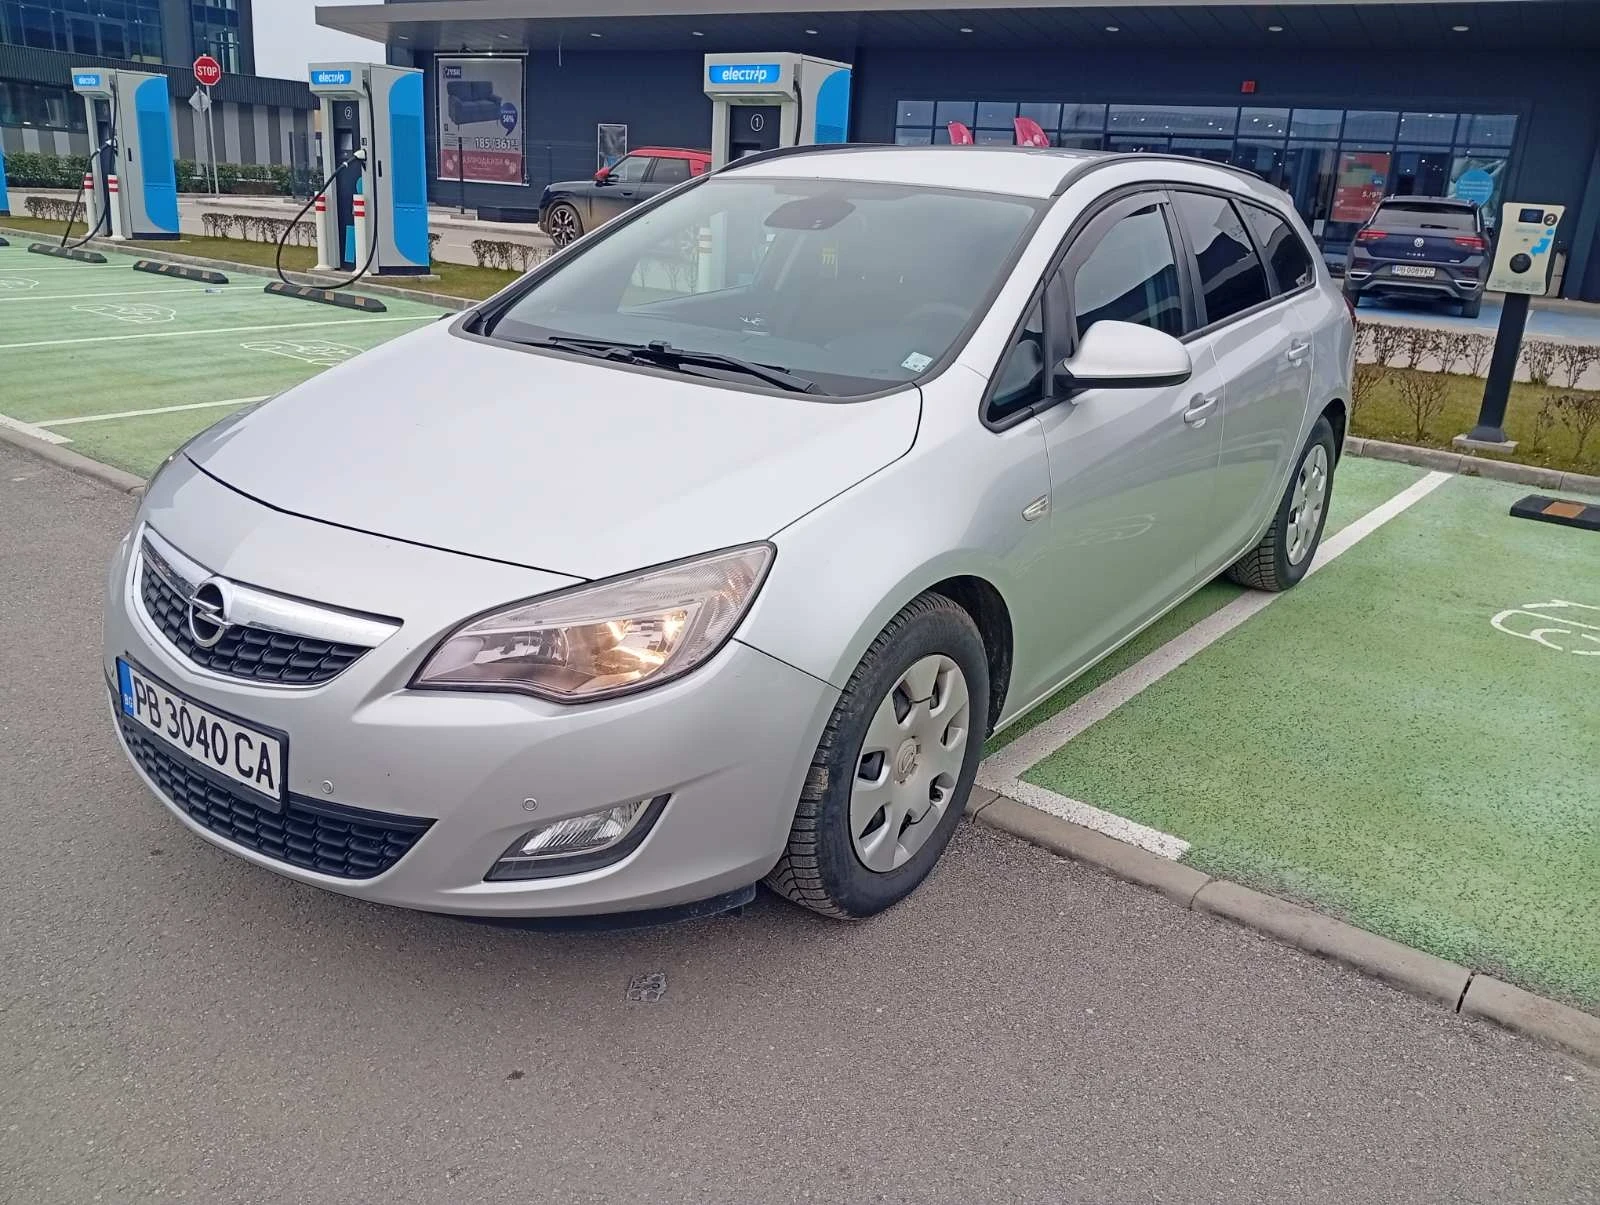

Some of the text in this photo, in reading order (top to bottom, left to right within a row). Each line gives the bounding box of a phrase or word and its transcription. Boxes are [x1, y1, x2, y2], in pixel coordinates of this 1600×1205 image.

[197, 66, 217, 77] STOP
[319, 71, 345, 84] electrip
[722, 66, 767, 83] electrip
[133, 675, 275, 790] PB 3040 CA
